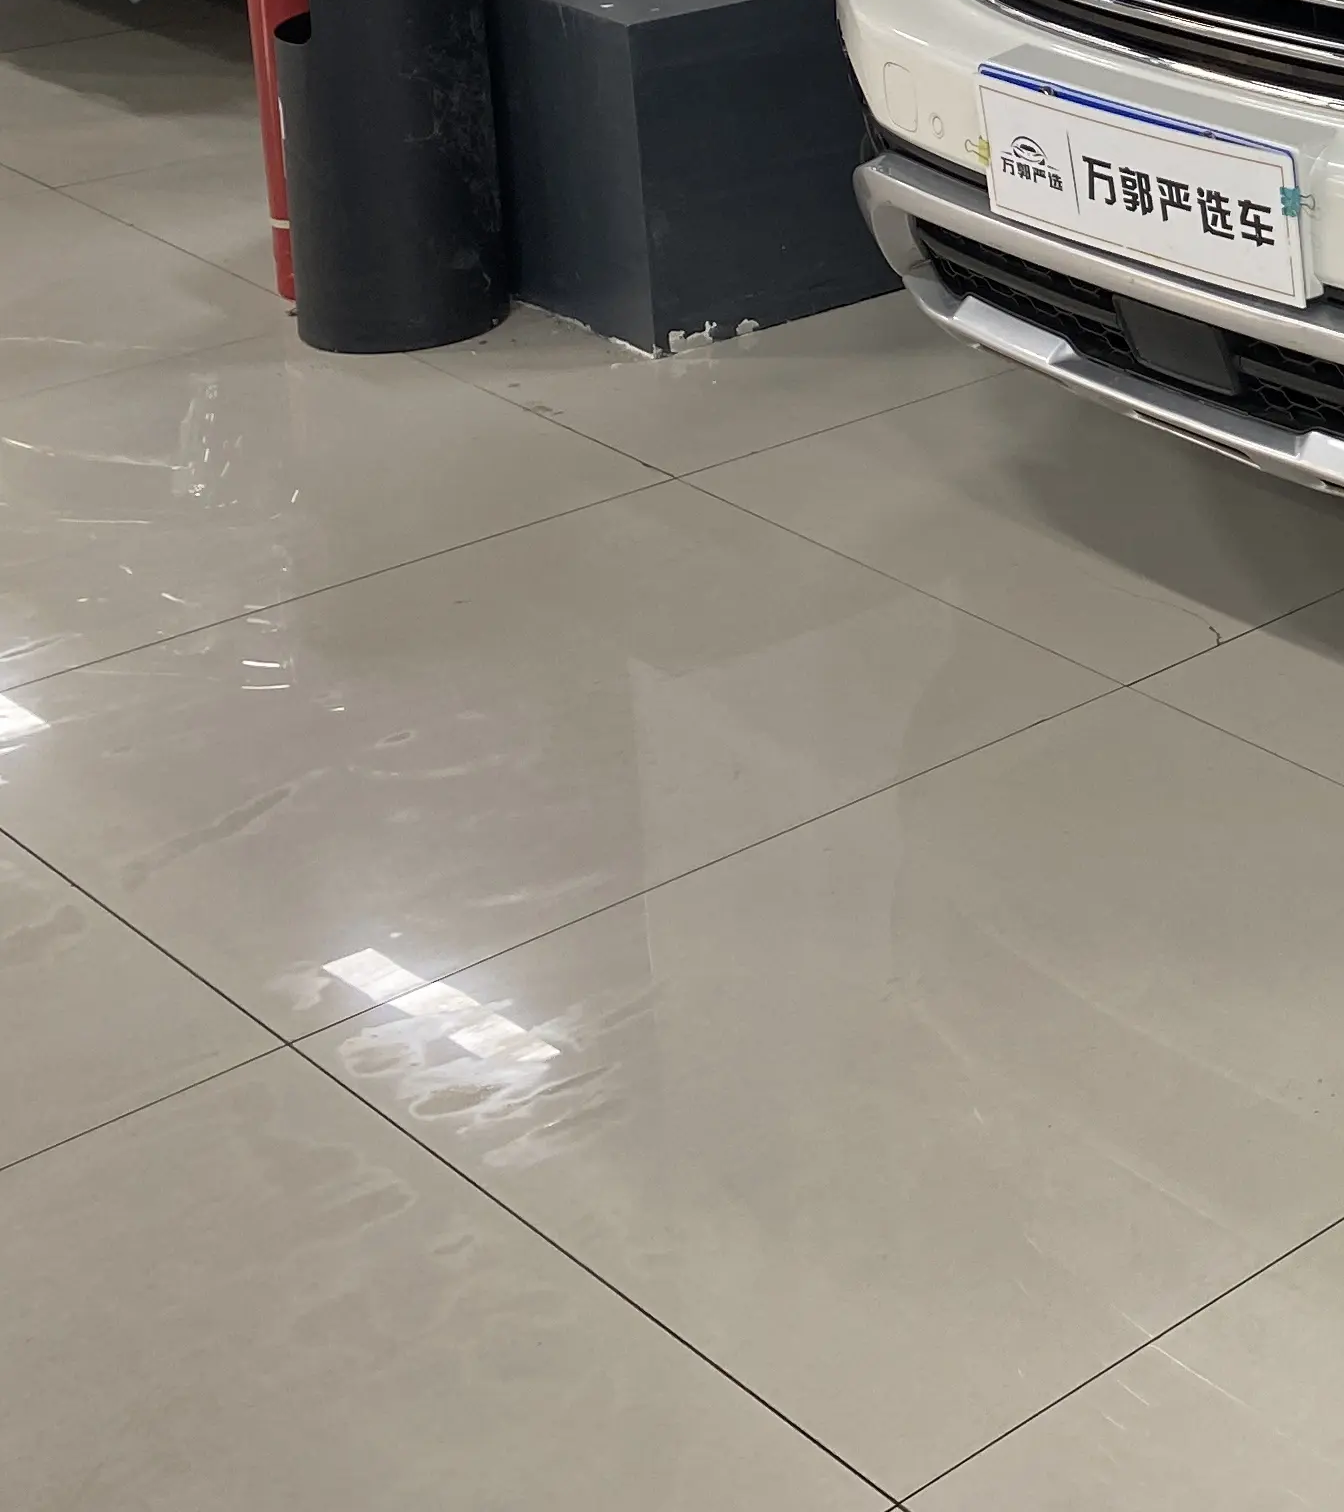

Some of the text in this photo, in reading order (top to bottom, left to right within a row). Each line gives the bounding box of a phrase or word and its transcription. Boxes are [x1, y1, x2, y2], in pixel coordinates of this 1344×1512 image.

[1000, 157, 1063, 192] 万郭严选
[1082, 155, 1275, 247] 万郭严选车
